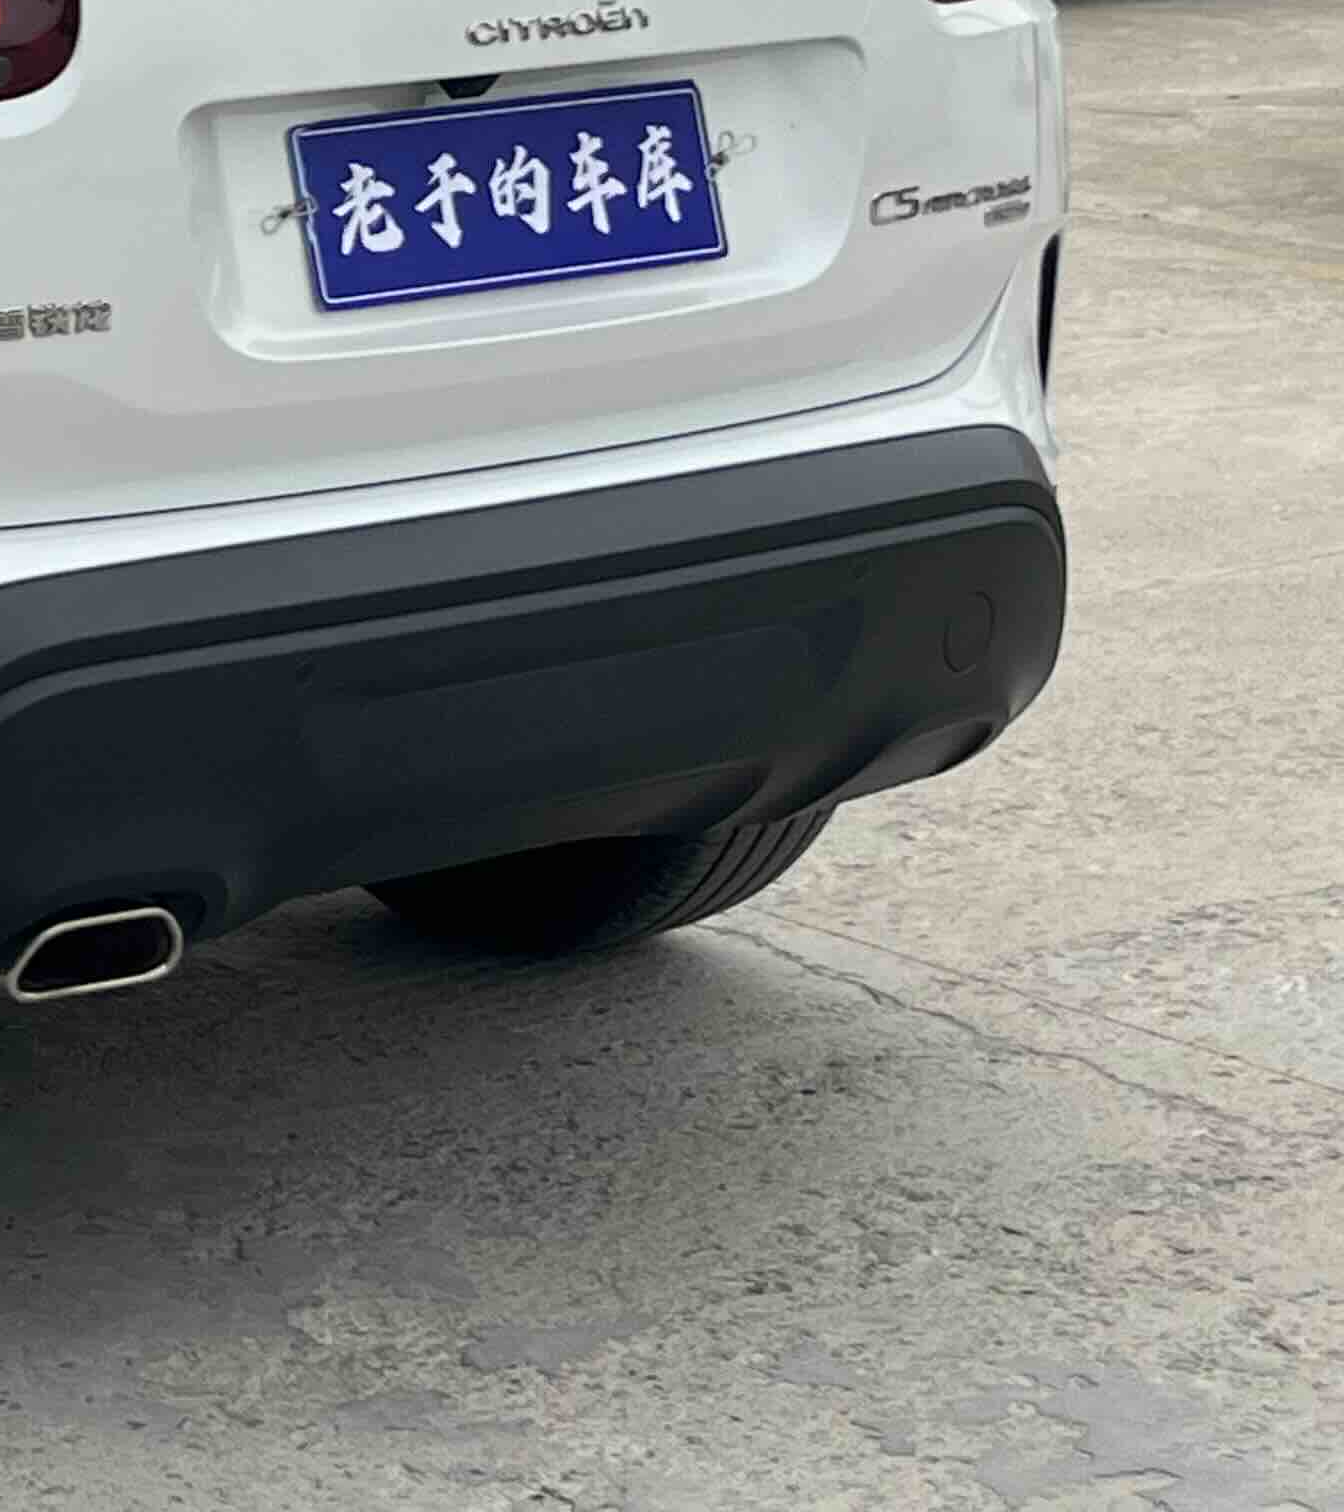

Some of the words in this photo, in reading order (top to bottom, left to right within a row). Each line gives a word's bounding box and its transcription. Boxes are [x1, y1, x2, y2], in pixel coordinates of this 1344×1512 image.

[331, 123, 694, 256] 老于的车库
